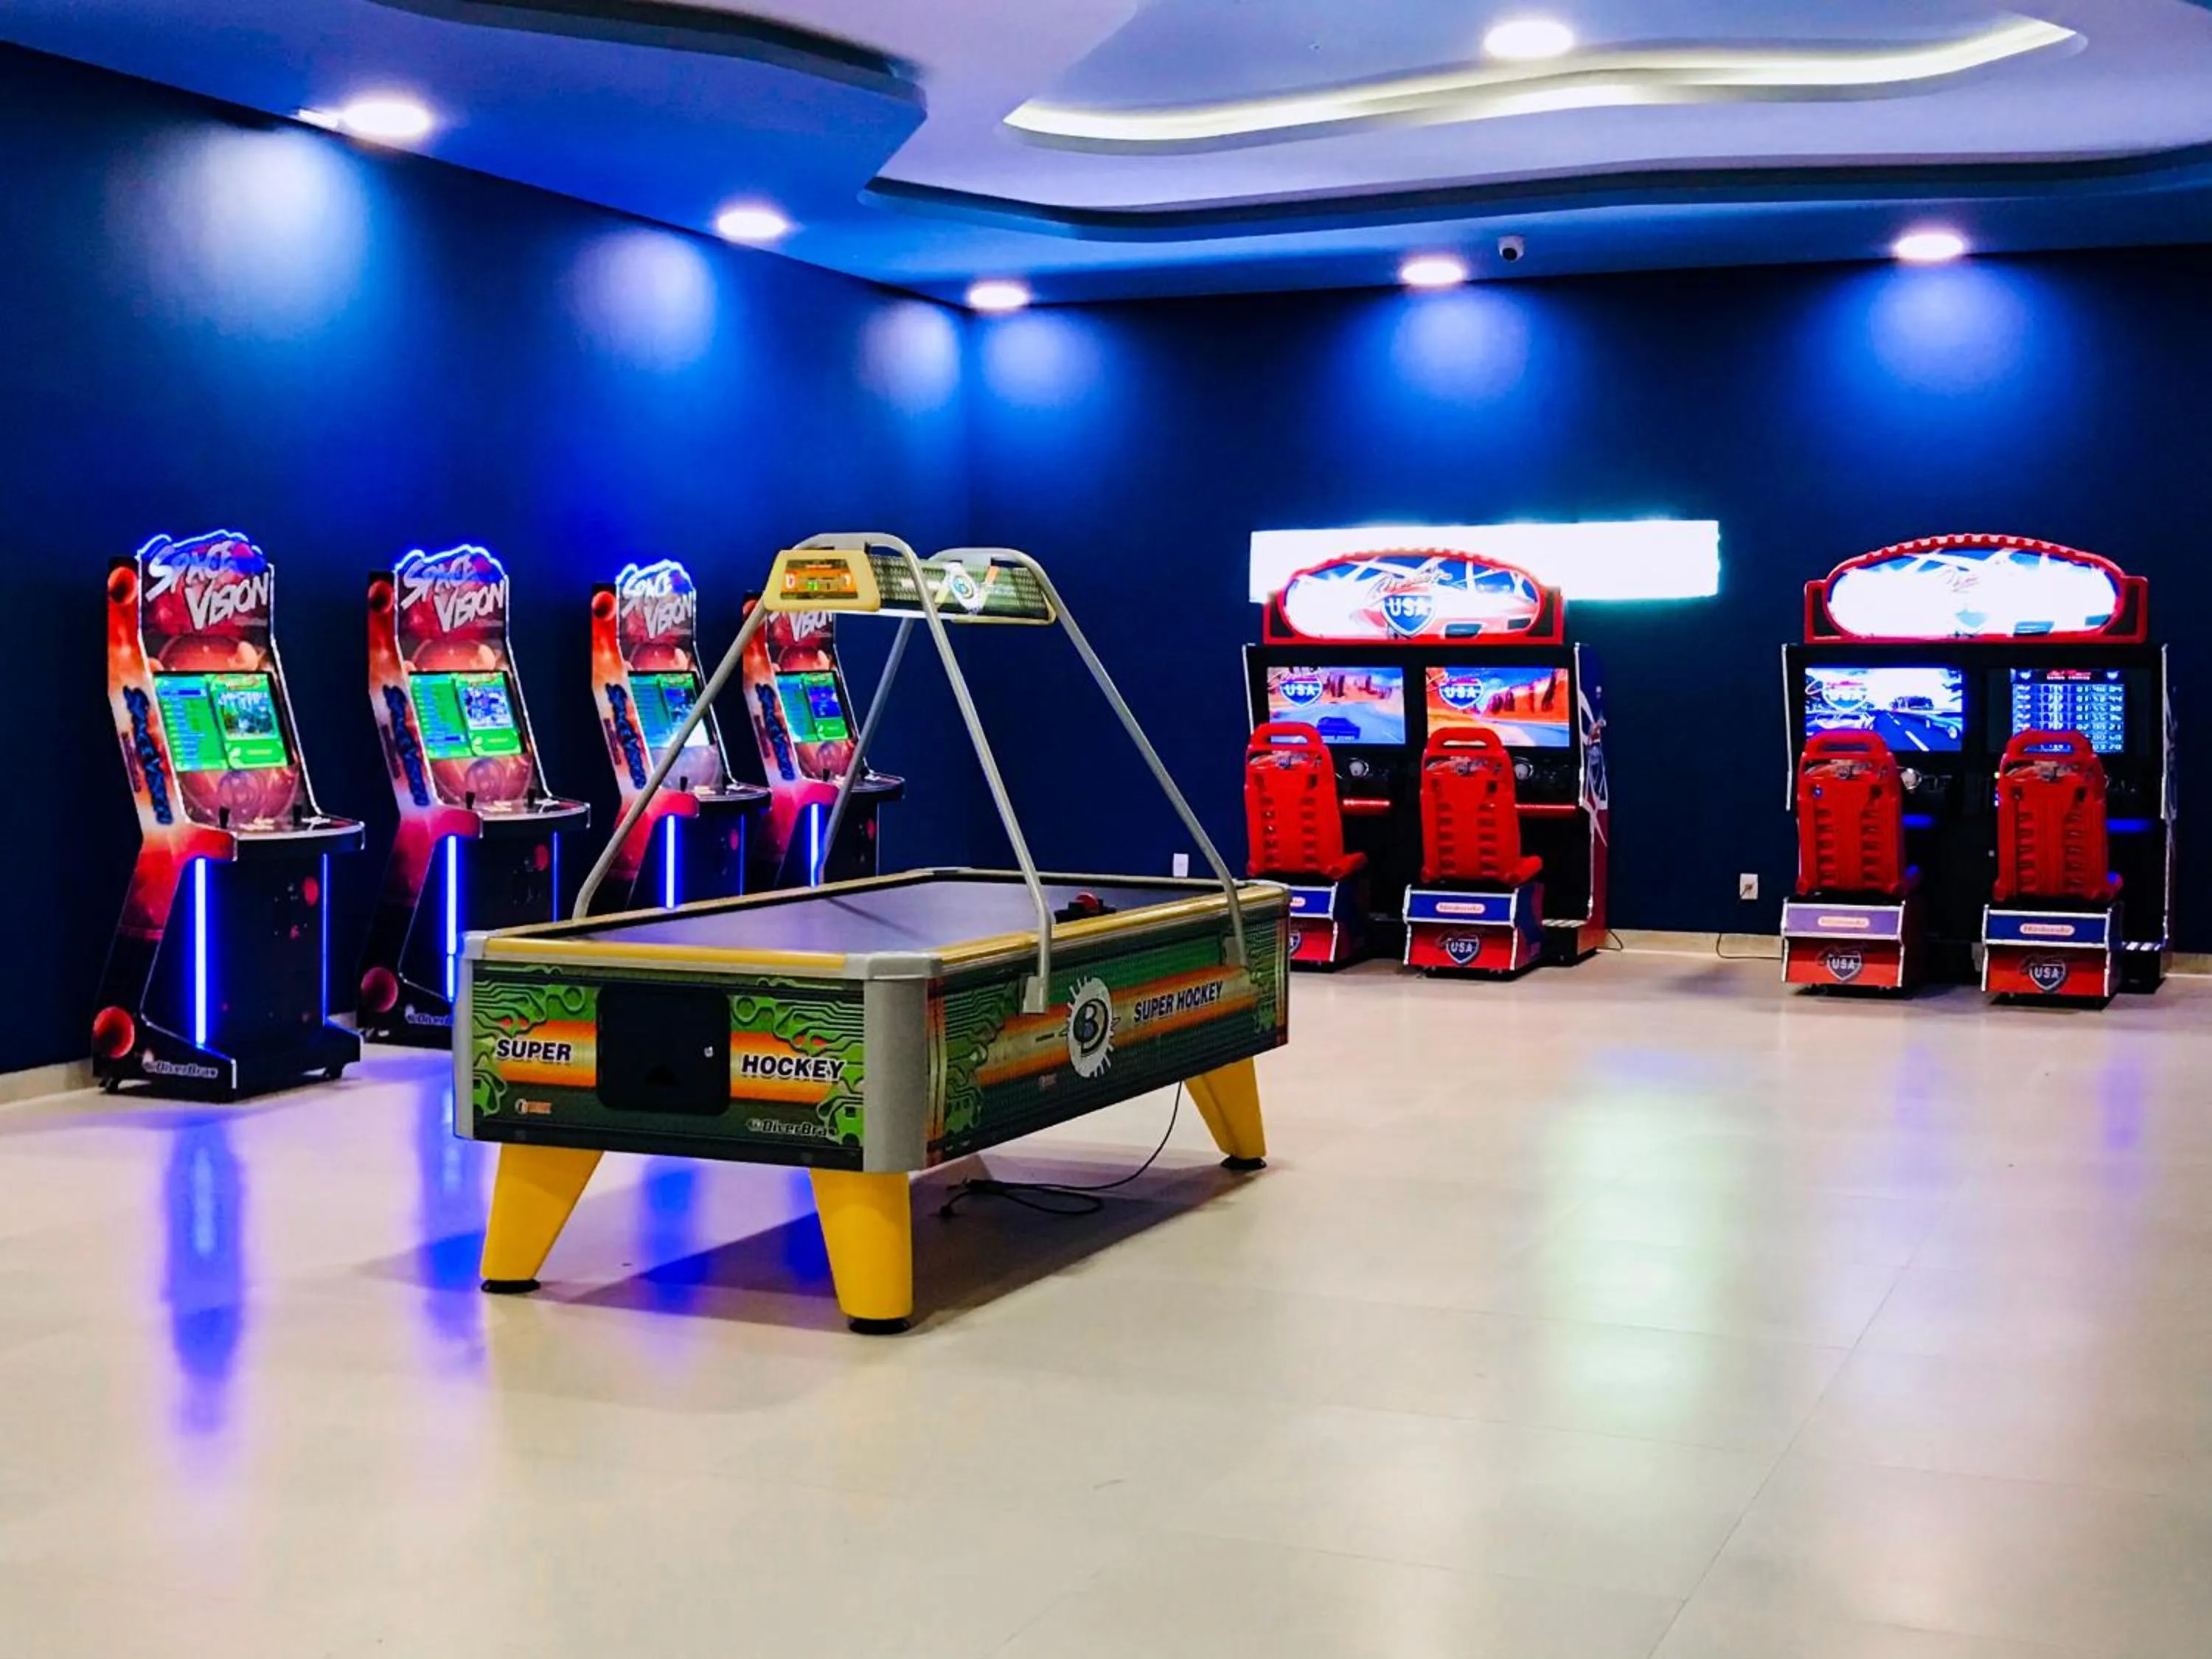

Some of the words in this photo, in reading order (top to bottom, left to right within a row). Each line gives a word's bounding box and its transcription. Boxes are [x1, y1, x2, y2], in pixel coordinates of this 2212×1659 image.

[146, 540, 234, 601] SPACE
[185, 572, 269, 630] VISION
[434, 580, 506, 633] VISION
[1385, 596, 1432, 617] USA
[1450, 941, 1474, 953] USA
[1832, 957, 1856, 970] USA
[2034, 966, 2059, 979] USA
[1133, 993, 1175, 1023] SUPER
[1176, 979, 1223, 1011] HOCKEY
[496, 1038, 572, 1061] SUPER
[741, 1054, 846, 1079] HOCKEY
